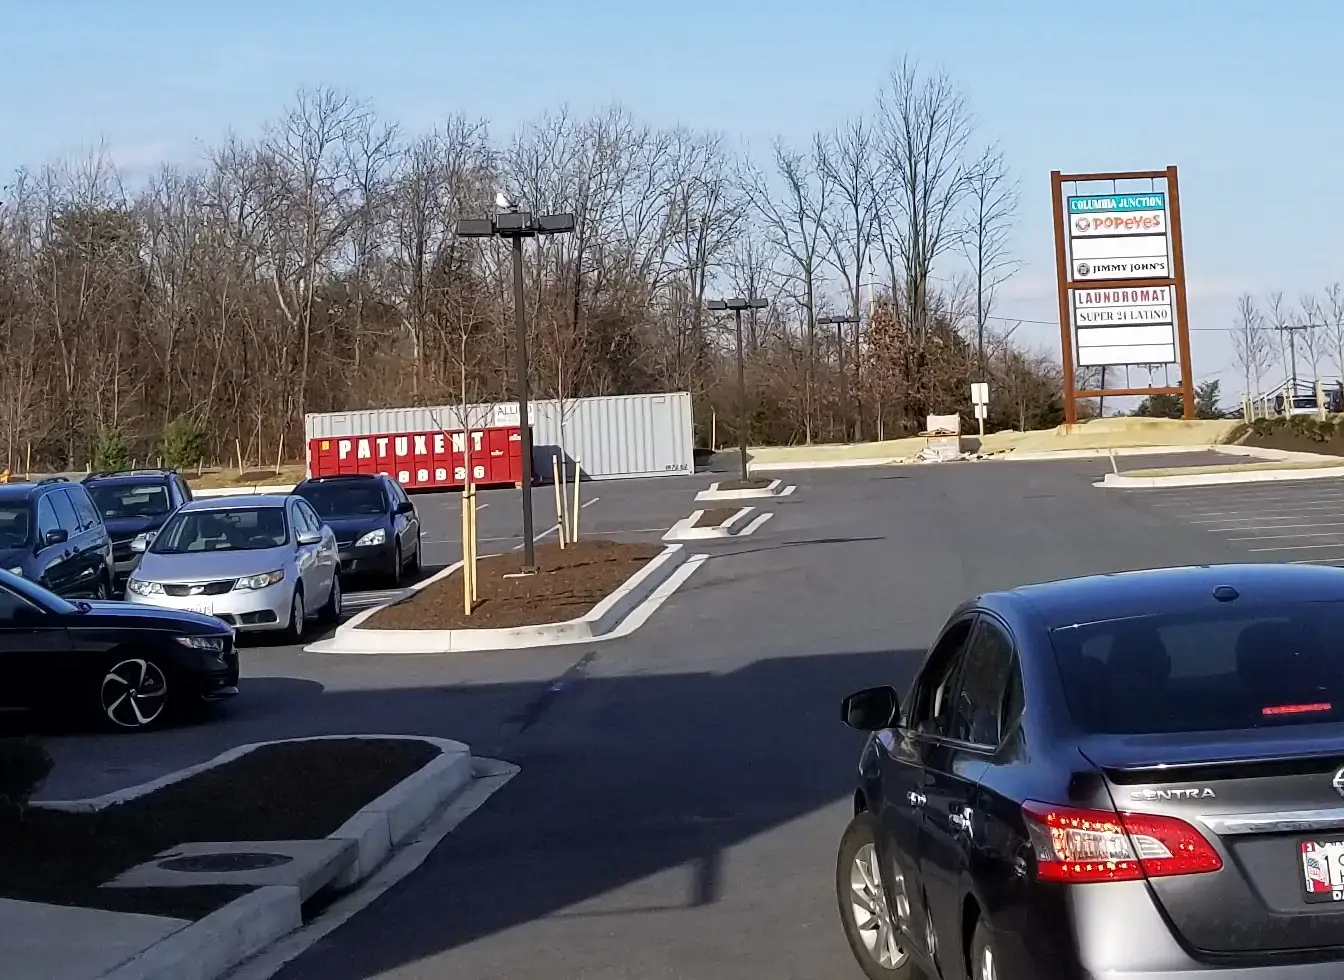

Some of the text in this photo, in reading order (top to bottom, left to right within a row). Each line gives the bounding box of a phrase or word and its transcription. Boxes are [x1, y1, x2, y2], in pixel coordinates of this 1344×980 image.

[1118, 196, 1162, 208] JUNCTION
[1093, 262, 1165, 274] JIMMY JOHN'S
[1078, 289, 1166, 305] LAUNDROMAT
[1080, 311, 1114, 322] SUPER
[1130, 309, 1168, 320] LATINO
[338, 431, 484, 460] PATUXENT
[1130, 787, 1216, 801] SENTRA
